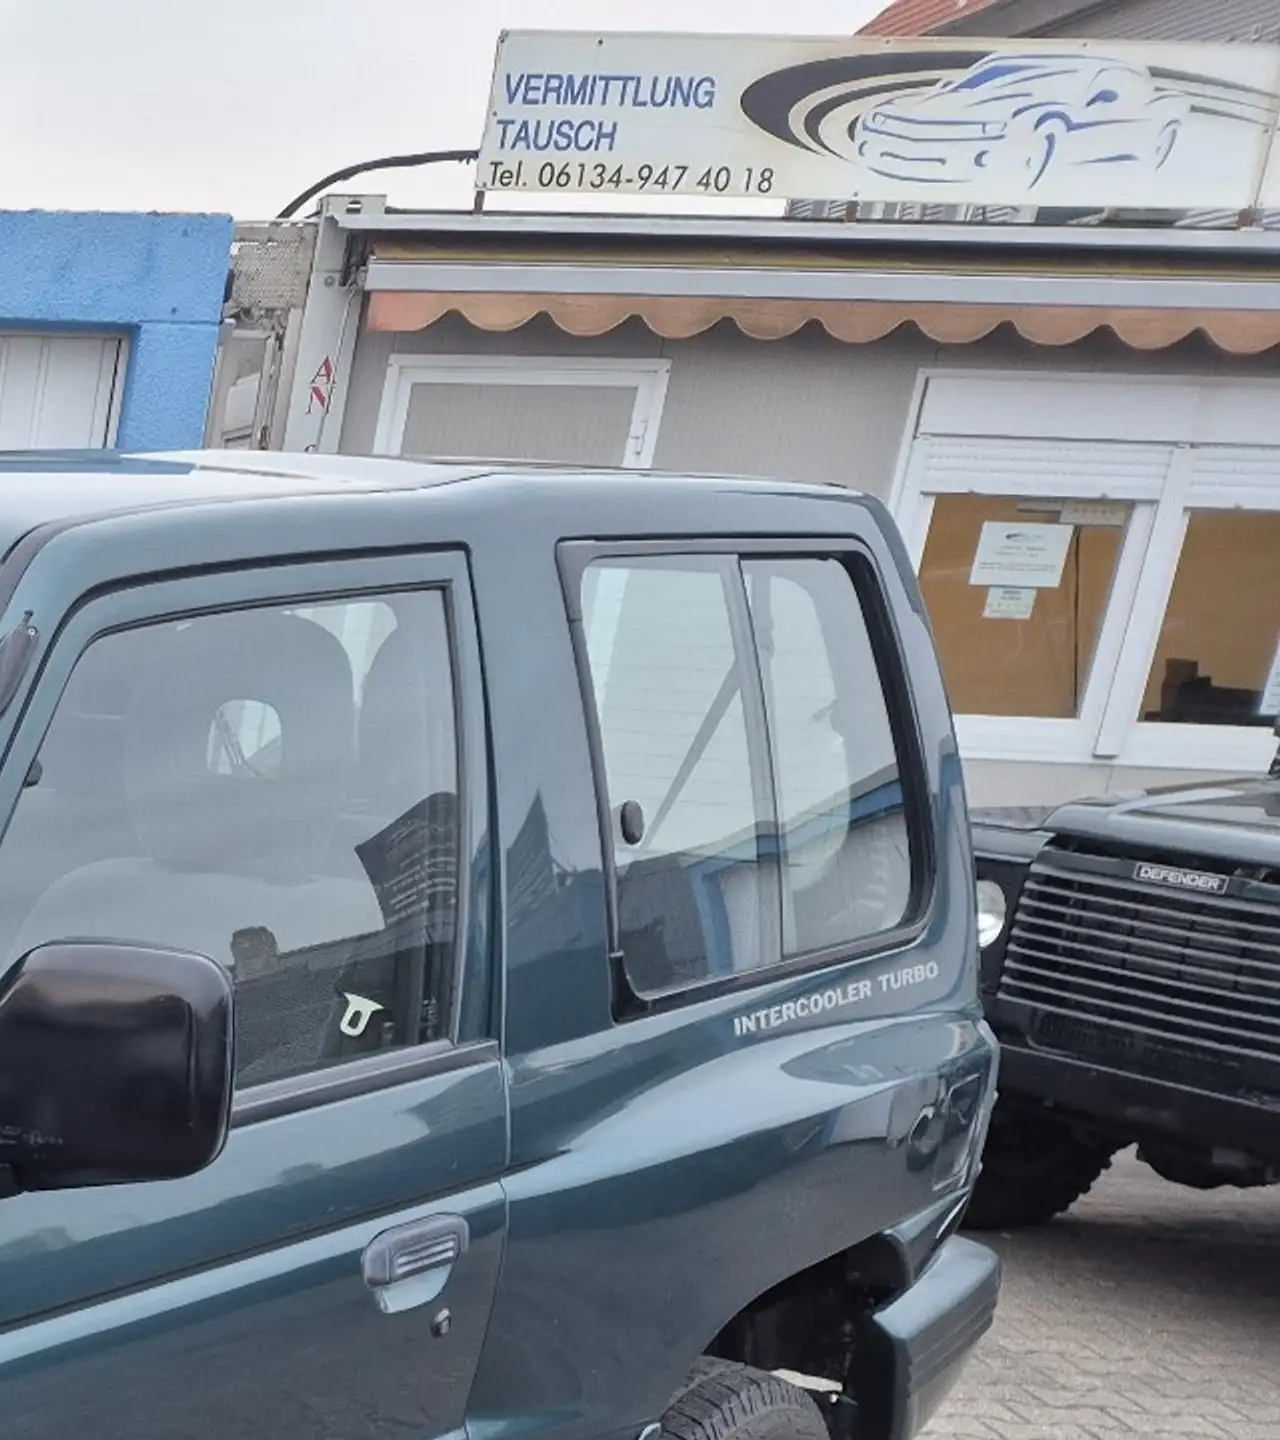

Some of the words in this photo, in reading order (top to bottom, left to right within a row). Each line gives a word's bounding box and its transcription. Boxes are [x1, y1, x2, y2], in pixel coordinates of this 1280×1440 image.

[505, 73, 716, 108] VERMITTLUNG
[496, 119, 617, 151] TAUSCH
[490, 160, 527, 187] Tel.
[538, 161, 689, 191] 06134-947
[696, 165, 731, 192] 40
[745, 167, 774, 193] 18
[1139, 865, 1221, 891] DEFENDER
[734, 980, 872, 1036] INTERCOOLER
[878, 960, 939, 993] TURBO
